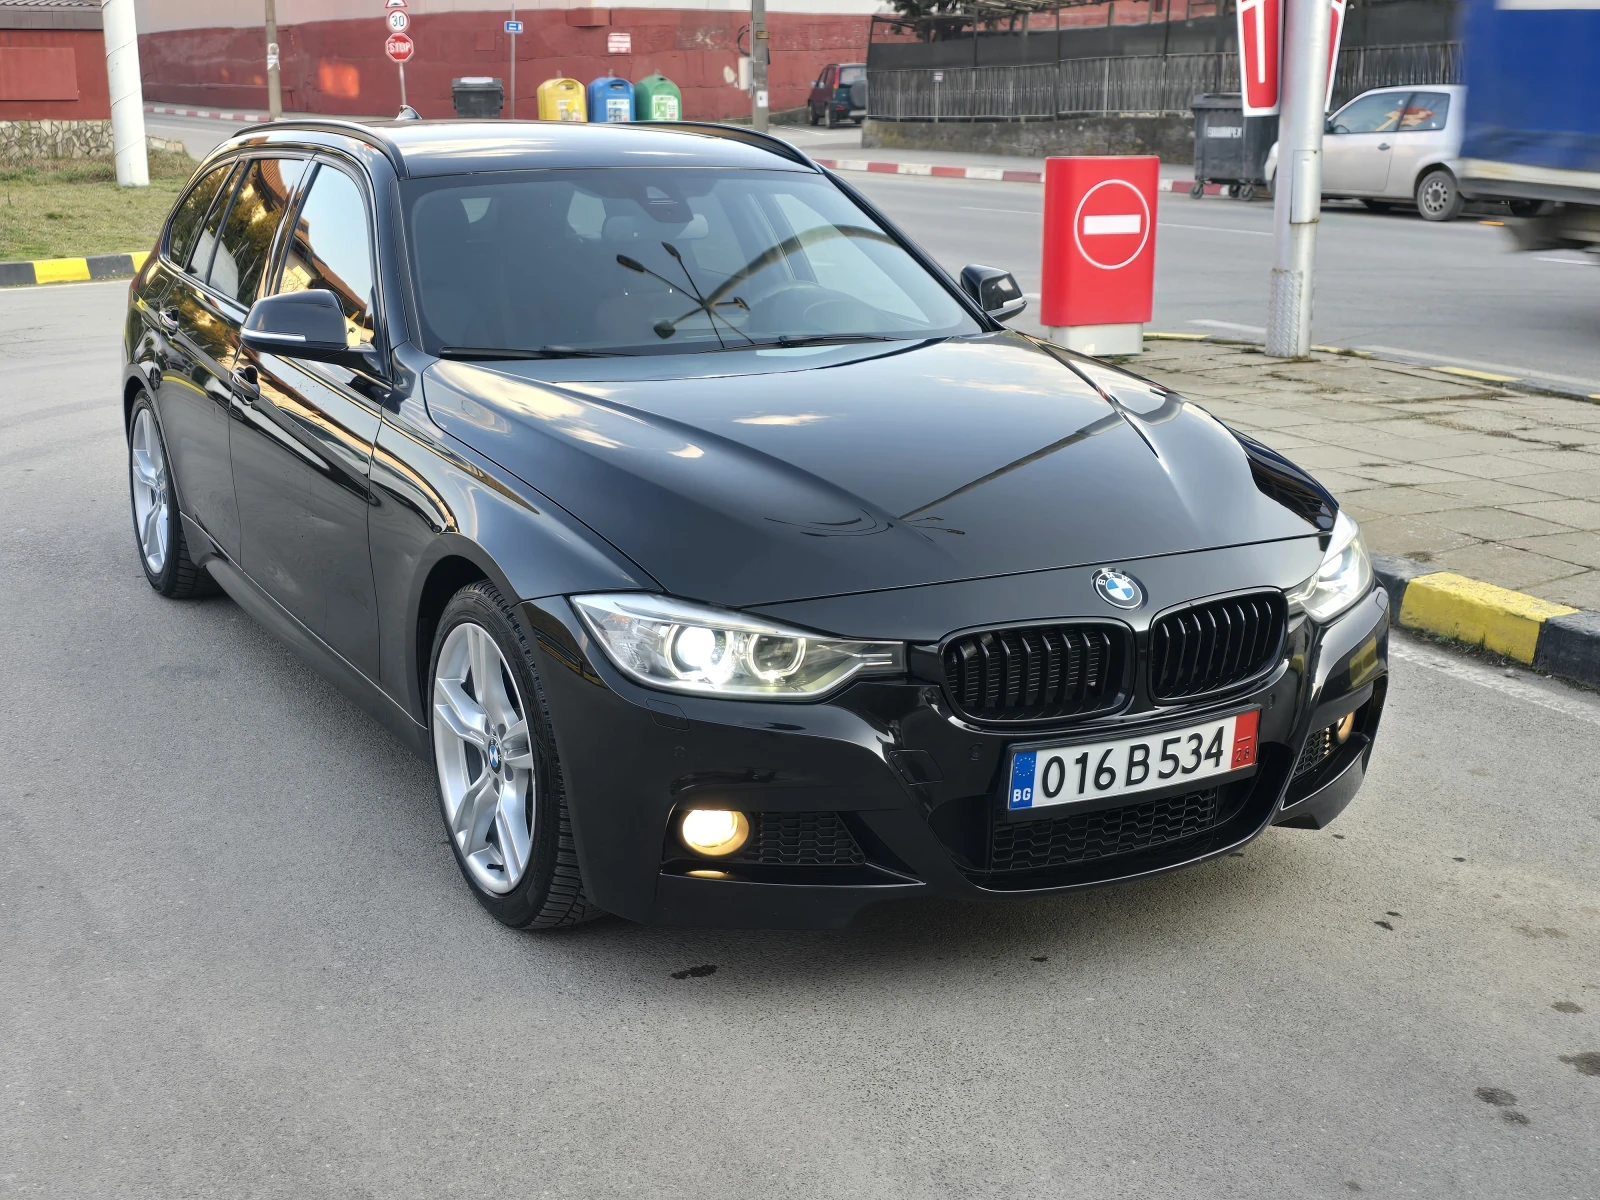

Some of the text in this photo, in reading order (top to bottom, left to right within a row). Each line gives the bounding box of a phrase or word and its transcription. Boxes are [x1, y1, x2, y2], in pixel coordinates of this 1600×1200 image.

[391, 14, 405, 27] 30
[388, 41, 411, 53] STOP
[1097, 572, 1131, 586] BMW
[1235, 745, 1250, 762] 28
[1012, 788, 1032, 803] BG
